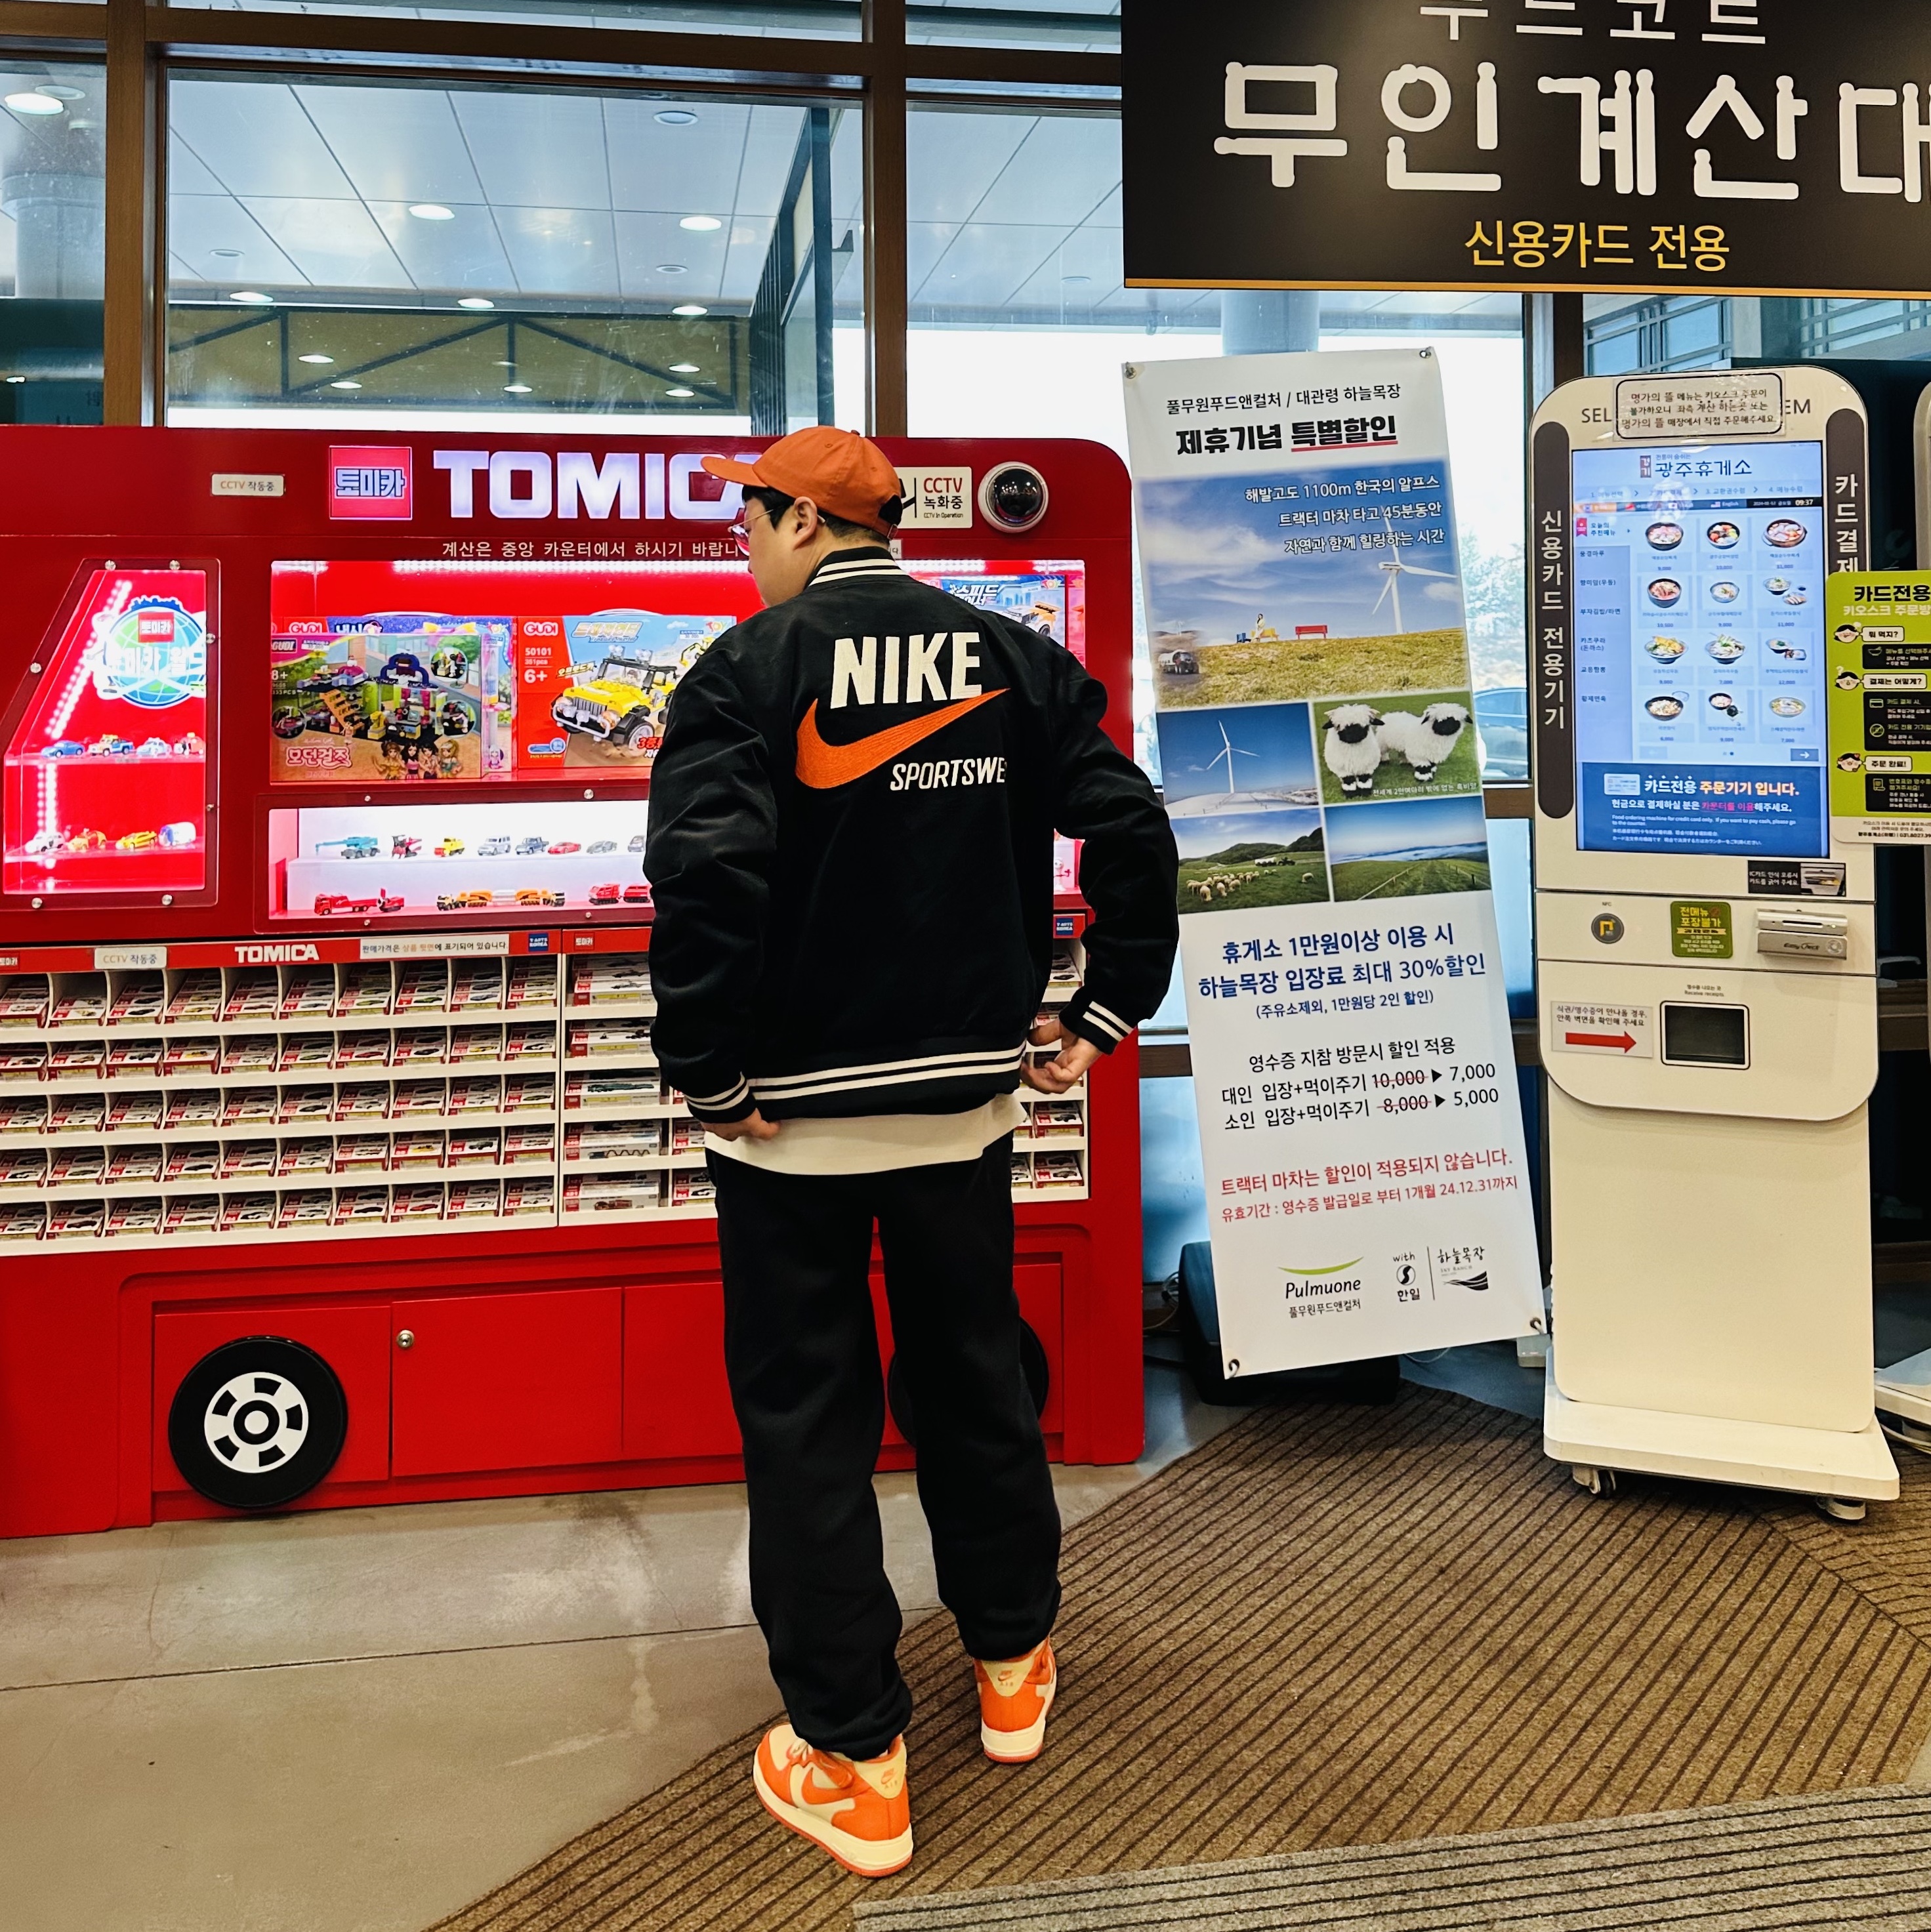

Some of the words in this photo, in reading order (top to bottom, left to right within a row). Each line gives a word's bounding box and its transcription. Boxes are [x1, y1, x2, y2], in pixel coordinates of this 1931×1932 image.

[1214, 61, 1931, 203] 무인계산대
[1465, 220, 1634, 268] 신용카드
[1648, 223, 1731, 272] 전용
[1167, 392, 1281, 415] 풀무원푸드앤컬처
[1296, 388, 1339, 406] 대관령
[1343, 383, 1402, 402] 하늘목장
[1677, 392, 1702, 401] 메뉴는
[1176, 424, 1282, 455] 제휴기념
[1291, 415, 1397, 447] 특별할인
[1655, 459, 1753, 478] 광주휴게소
[220, 480, 245, 490] CCTV
[247, 480, 274, 491] 작동중
[335, 468, 405, 497] 토미카
[924, 477, 963, 493] CCTV
[1245, 485, 1300, 503] 해발고도
[1303, 483, 1352, 499] 1100m
[1354, 478, 1395, 495] 한국의
[1398, 475, 1440, 491] 알프스
[924, 495, 963, 510] 녹화중
[1278, 512, 1319, 527] 트랙터
[1323, 508, 1350, 525] 마차
[1353, 506, 1381, 522] 타고
[1382, 501, 1442, 520] 45분동안
[442, 541, 492, 558] 계산은
[501, 541, 534, 558] 중앙
[544, 541, 626, 558] 카운터에서
[635, 542, 683, 558] 하시기
[692, 543, 739, 558] 바랍니
[1285, 537, 1326, 555] 자연과
[1329, 535, 1357, 552] 함께
[1359, 531, 1414, 550] 힐링하는
[1417, 528, 1445, 545] 시간
[1541, 510, 1564, 611] 신용카드
[1844, 605, 1891, 616] 키오스크
[524, 623, 558, 636] GUDI
[525, 647, 551, 656] 50101
[524, 669, 547, 683] 6+
[830, 632, 982, 709] NIKE
[1543, 627, 1565, 730] 전용기기
[890, 756, 1007, 791] SPORTSWE
[1644, 777, 1696, 794] 카드전용
[1699, 780, 1752, 795] 주문기기
[1755, 781, 1800, 796] 입니다.
[1611, 799, 1645, 809] 현금으로
[1647, 800, 1680, 810] 결제하실
[1682, 800, 1699, 811] 분은
[1680, 907, 1709, 917] 전메뉴
[1681, 918, 1721, 928] 포장불가
[235, 943, 320, 963] TOMICA
[362, 943, 400, 954] 판매가격은
[444, 941, 474, 951] 표기되어
[1222, 939, 1283, 964] 휴게소
[1288, 929, 1380, 957] 1만원이상
[1387, 924, 1427, 949] 이용
[1434, 922, 1455, 945] 시
[103, 955, 127, 964] CCTV
[130, 954, 157, 965] 작동중
[1198, 970, 1279, 1000] 하늘목장
[1285, 966, 1346, 992] 입장료
[1352, 960, 1392, 984] 최대
[1400, 952, 1487, 980] 30%할인
[1256, 998, 1328, 1019] (주유소제외,
[1331, 993, 1376, 1012] 1만원당
[1380, 991, 1400, 1008] 2인
[1403, 989, 1434, 1006] 할인)
[1249, 1052, 1297, 1073] 영수증
[1300, 1048, 1332, 1068] 지참
[1336, 1042, 1384, 1064] 방문시
[1388, 1040, 1420, 1059] 할인
[1423, 1036, 1456, 1055] 적용
[1222, 1085, 1253, 1106] 대인
[1261, 1073, 1367, 1102] 입장+먹이주기
[1371, 1069, 1426, 1090] 10,000
[1449, 1063, 1496, 1082] 7,000
[1224, 1111, 1255, 1131] 소인
[1265, 1099, 1370, 1128] 입장+먹이주기
[1453, 1088, 1499, 1108] 5,000
[1220, 1174, 1268, 1197] 트랙터
[1272, 1168, 1320, 1193] 마차는
[1324, 1162, 1372, 1185] 할인이
[1377, 1155, 1440, 1179] 적용되지
[1443, 1148, 1514, 1172] 않습니다.
[1221, 1203, 1271, 1223] 유효기간
[1282, 1197, 1320, 1215] 영수증
[1323, 1191, 1373, 1211] 발급일로
[1377, 1187, 1402, 1204] 부터
[1405, 1183, 1436, 1201] 1개월
[1440, 1175, 1518, 1197] 24.12.31까지
[1393, 1252, 1415, 1263] with
[1437, 1246, 1485, 1264] 하늘목장
[1285, 1279, 1361, 1300] Pulmuone
[1397, 1288, 1421, 1303] 한일
[1289, 1298, 1361, 1319] 풀무원푸드앤컬처
